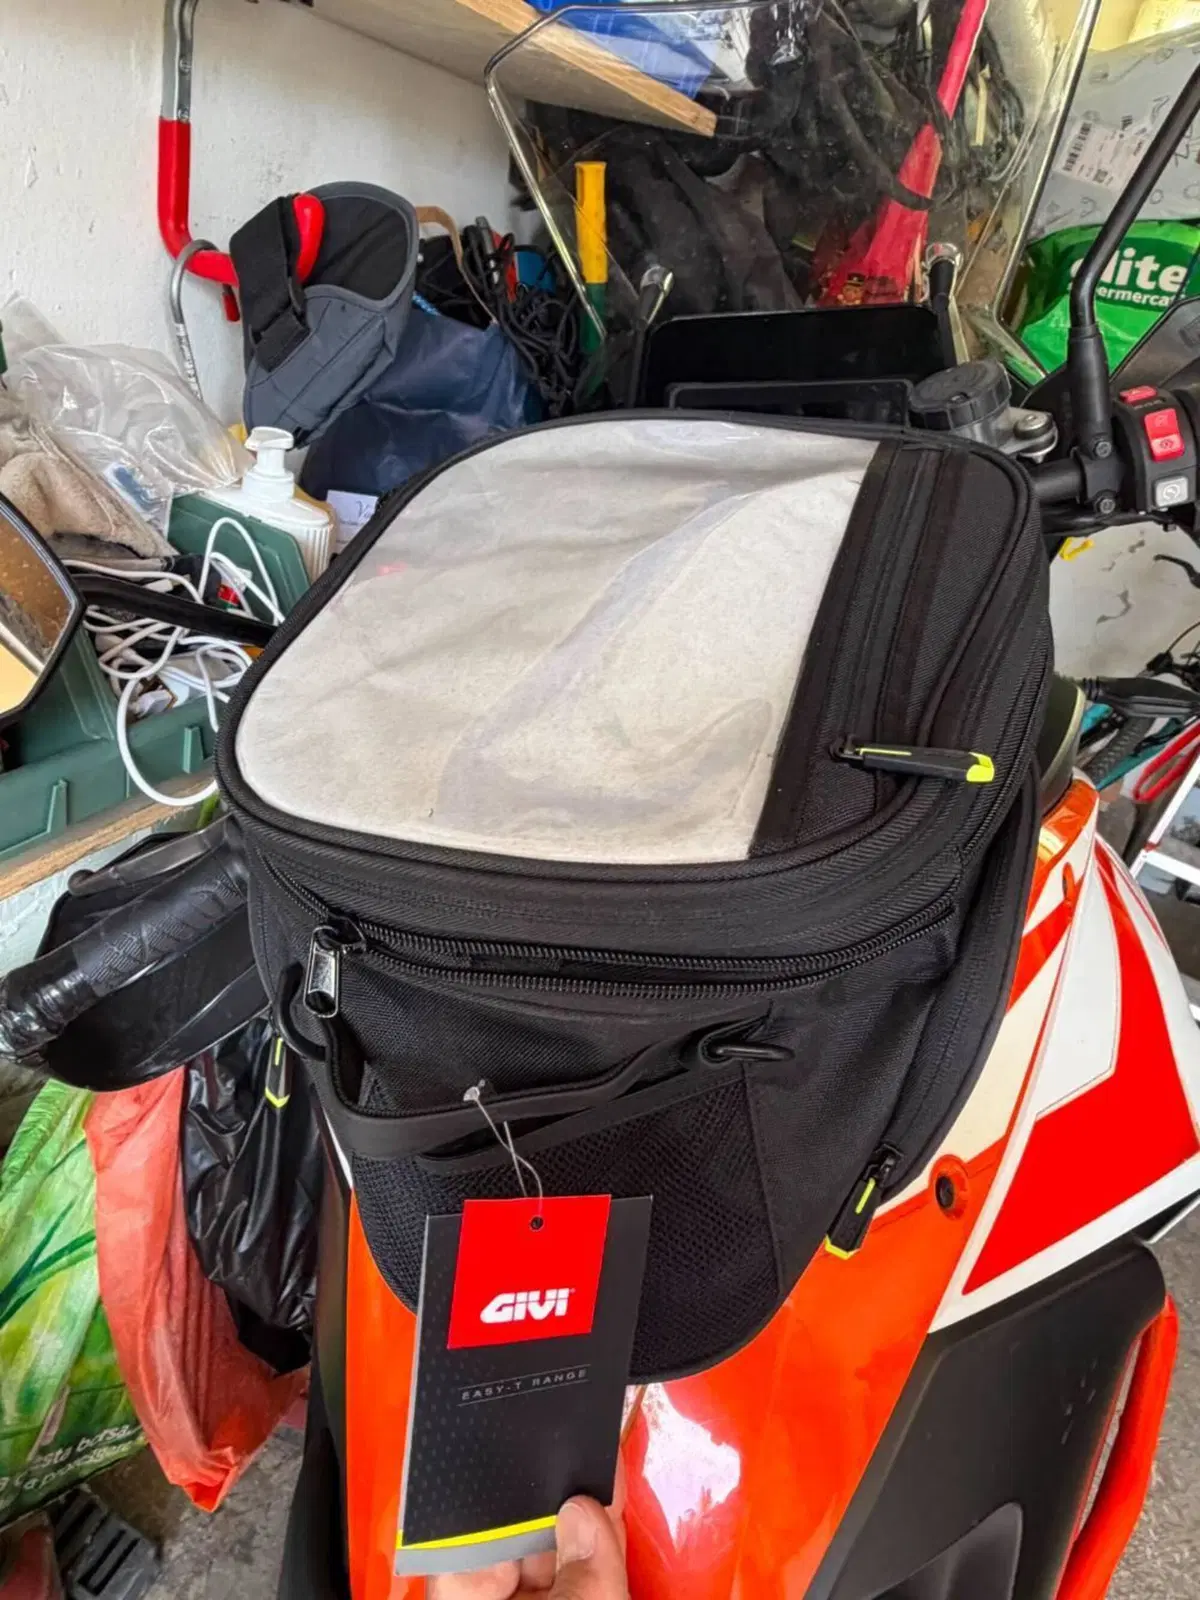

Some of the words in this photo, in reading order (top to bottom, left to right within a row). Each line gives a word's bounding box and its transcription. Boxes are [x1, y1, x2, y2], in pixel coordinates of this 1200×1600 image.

[480, 1288, 570, 1324] GIVI
[461, 1382, 522, 1401] EASY-T
[532, 1369, 587, 1387] RANGE
